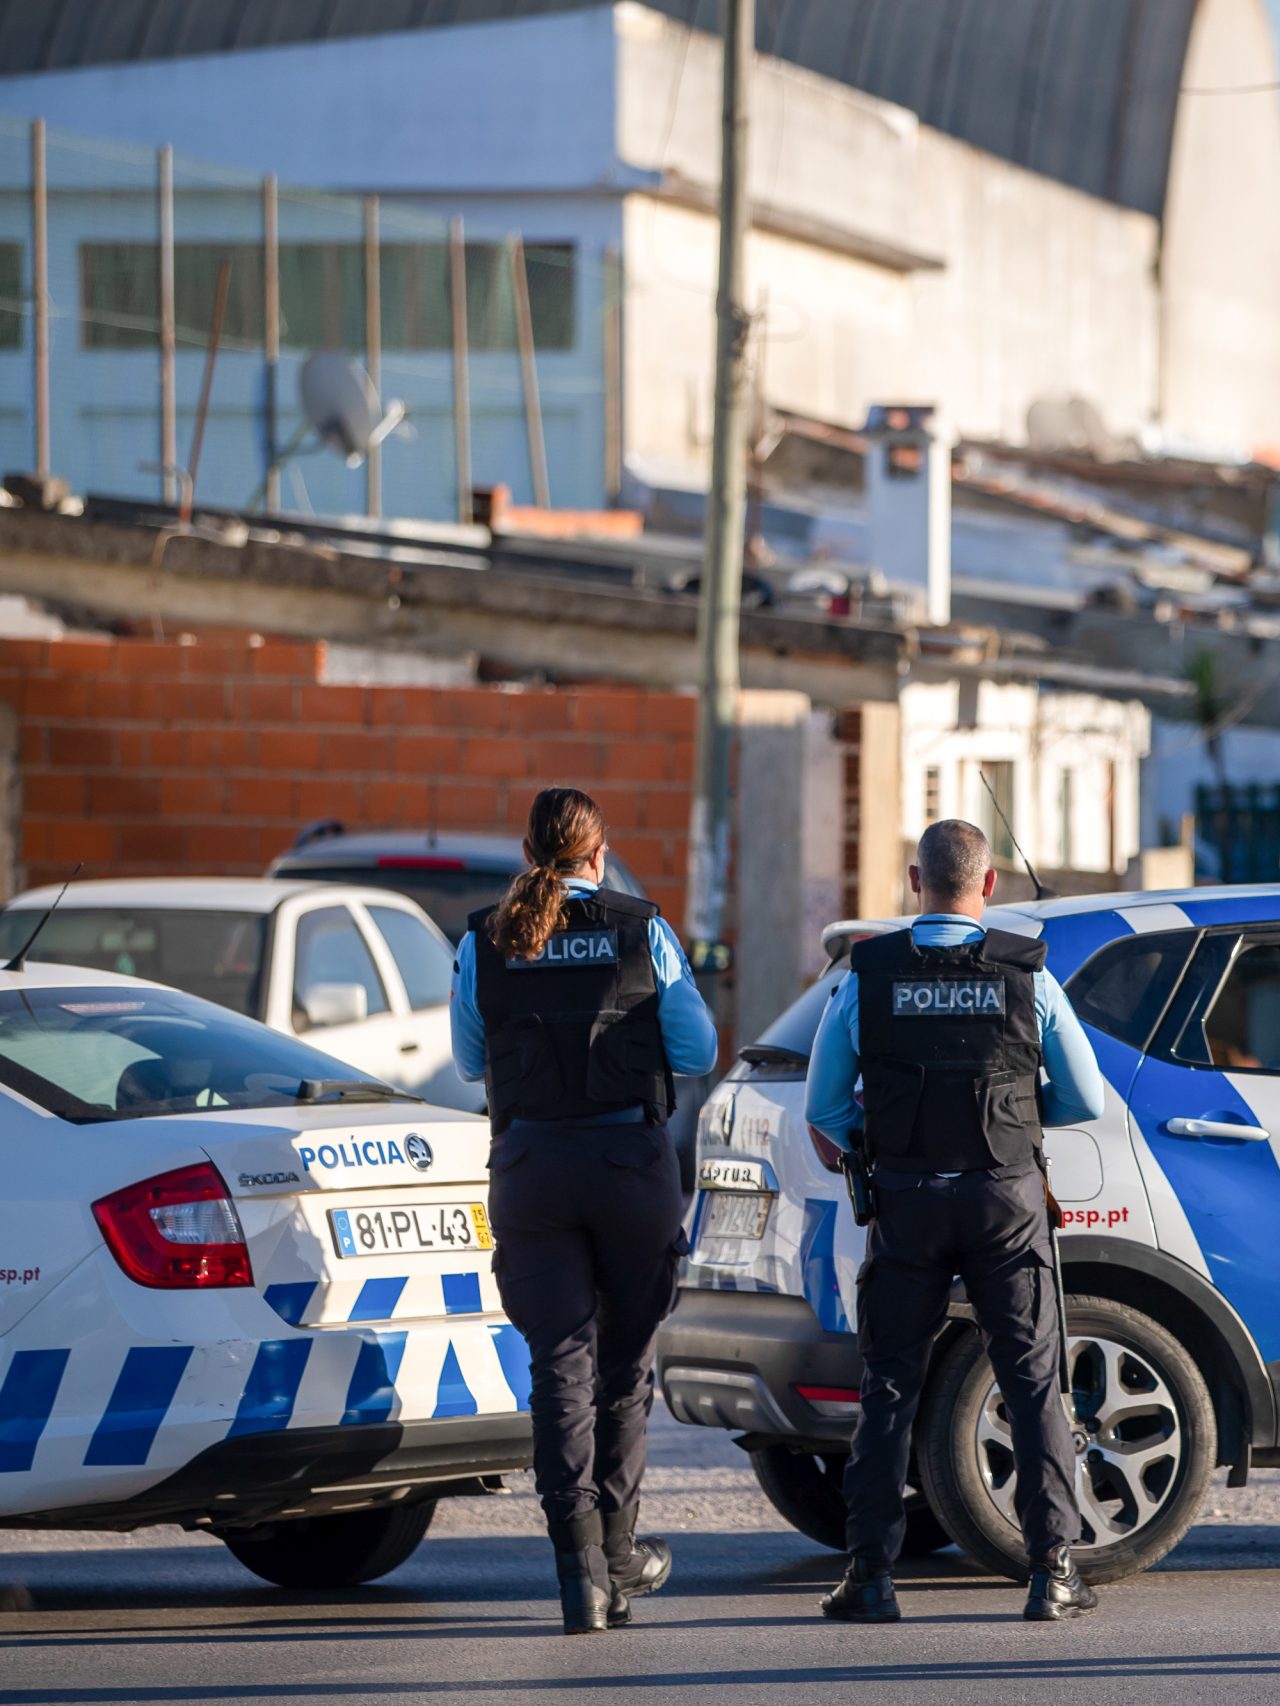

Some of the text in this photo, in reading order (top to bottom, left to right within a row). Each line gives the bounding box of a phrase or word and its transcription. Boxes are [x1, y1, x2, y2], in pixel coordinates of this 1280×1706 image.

[533, 937, 614, 961] LICIA
[897, 987, 1000, 1009] POLICIA
[299, 1134, 405, 1172] POLÍCIA
[1061, 1206, 1129, 1229] psp.pt
